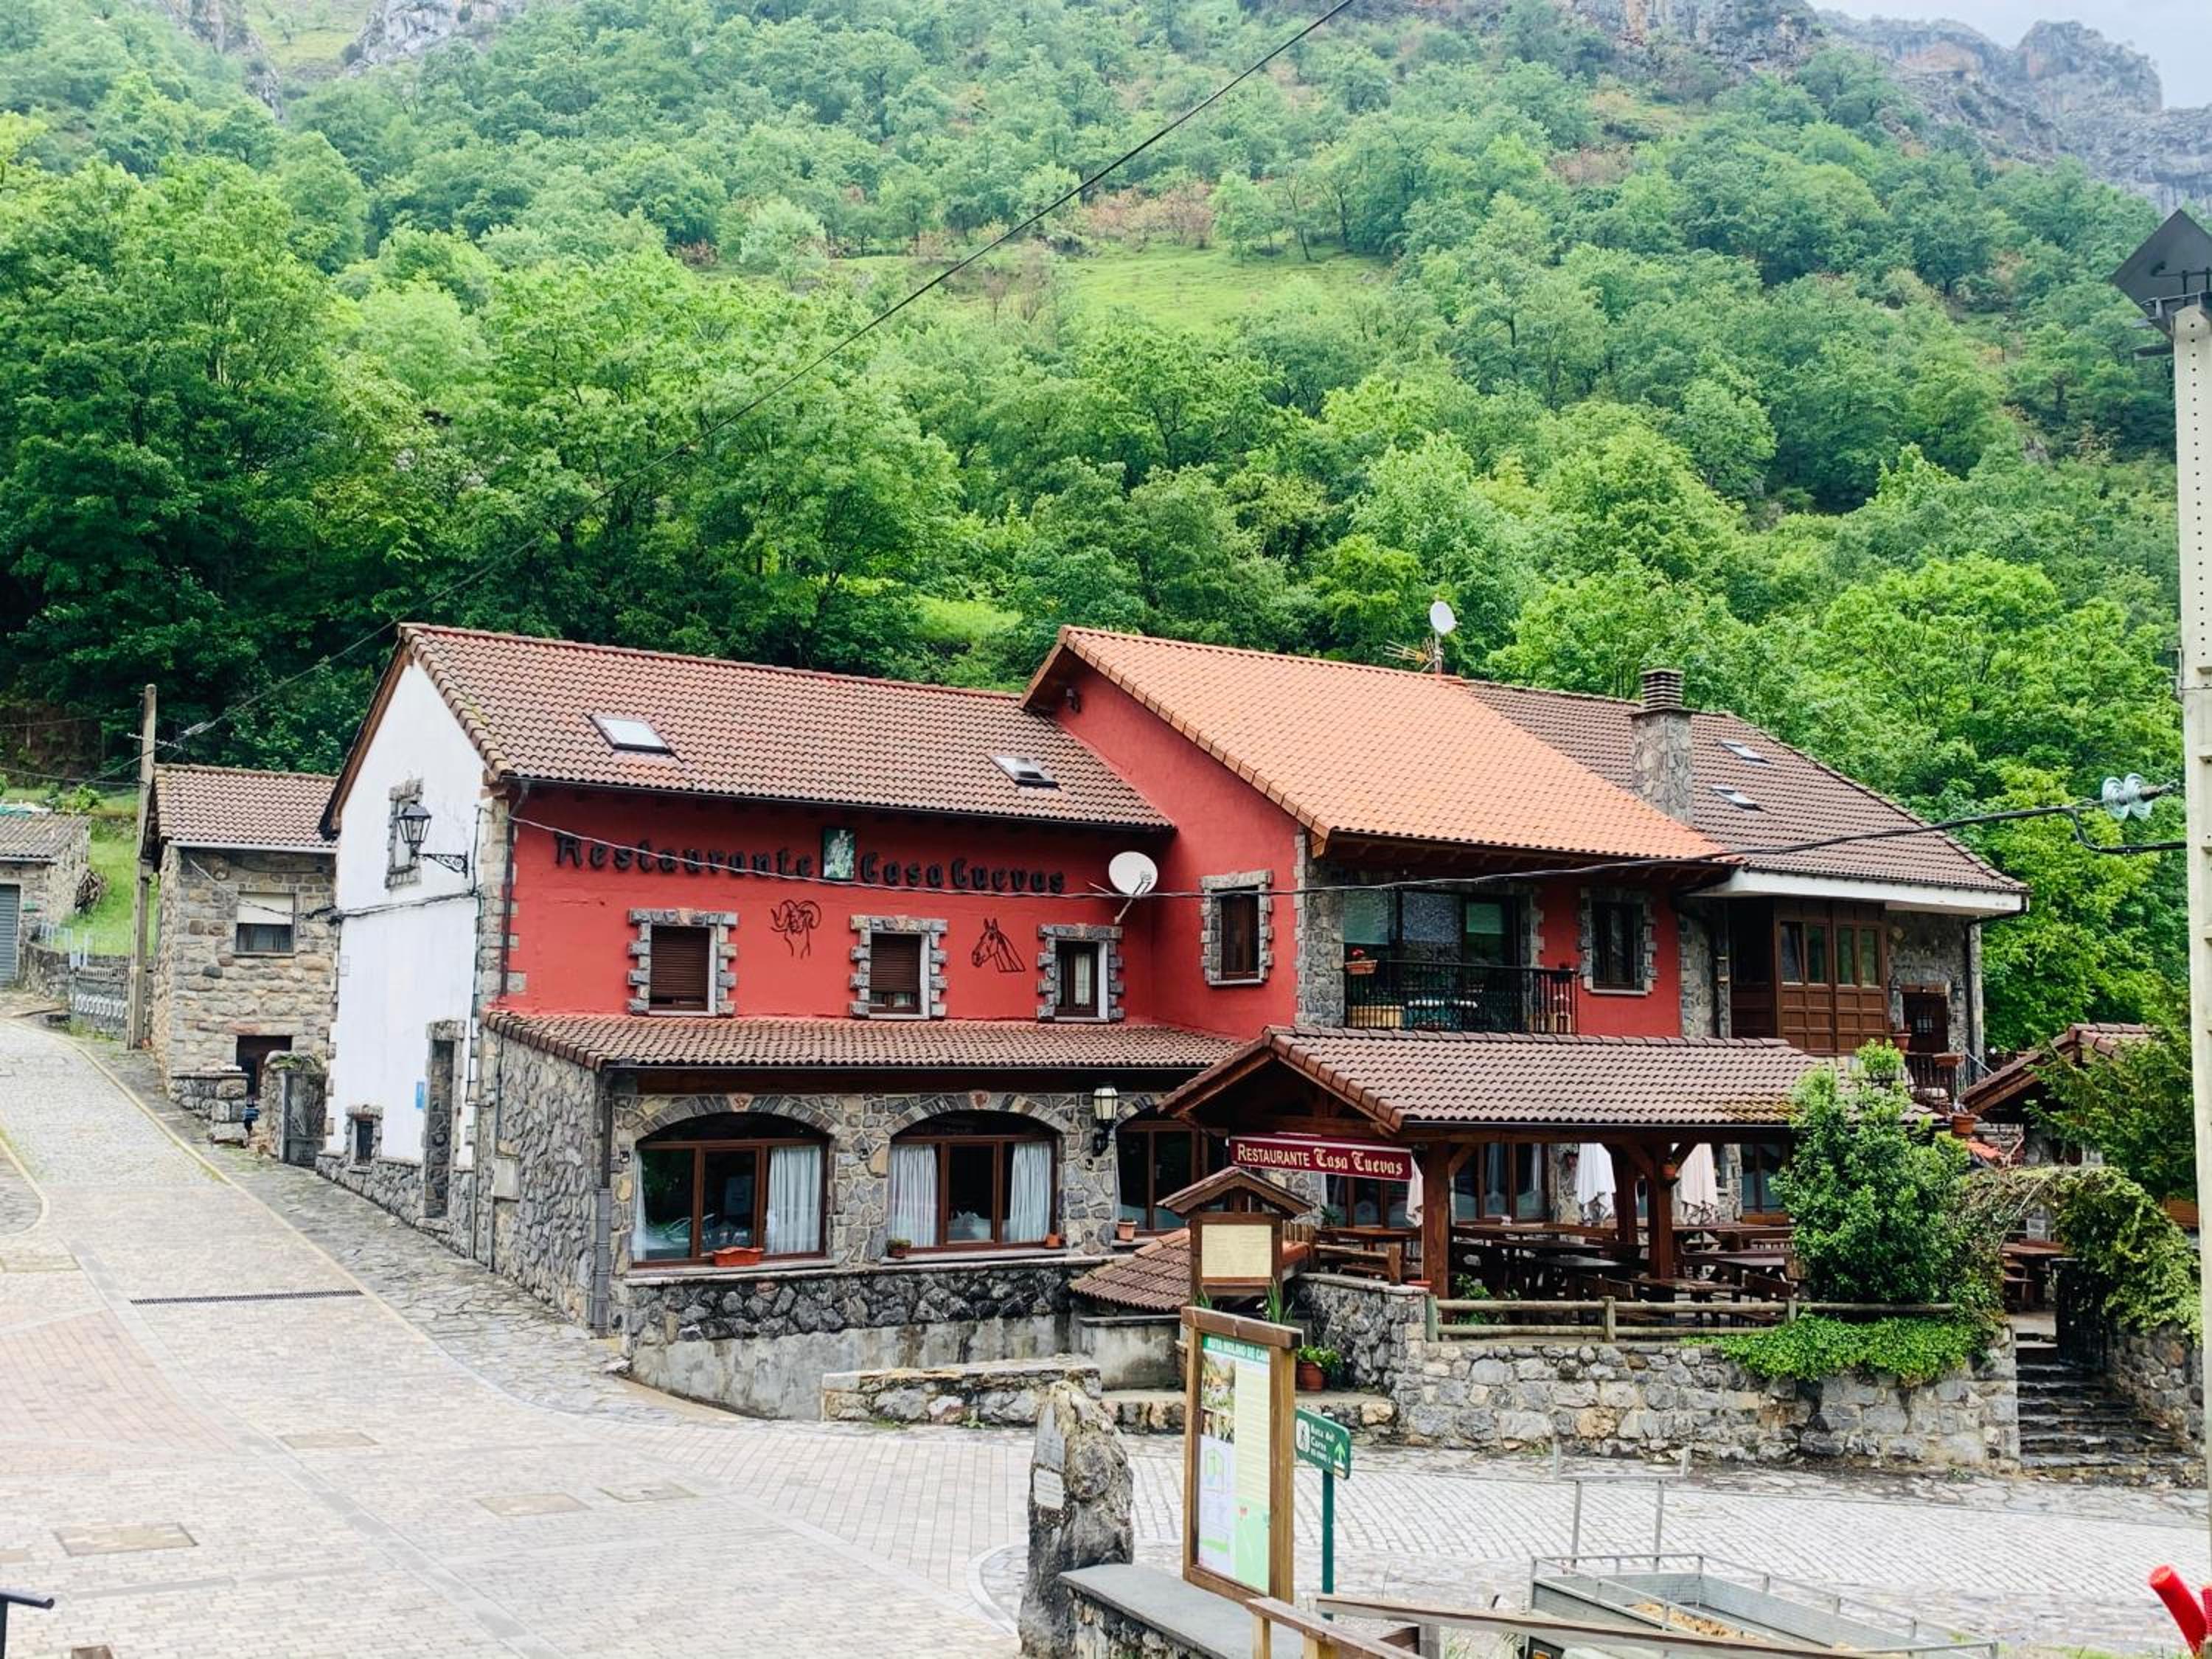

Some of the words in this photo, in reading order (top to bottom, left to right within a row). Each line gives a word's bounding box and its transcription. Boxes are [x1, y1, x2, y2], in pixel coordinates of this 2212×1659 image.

[555, 833, 813, 878] Restaurante
[860, 852, 945, 887] Casa
[950, 857, 1065, 894] Cuevas
[1237, 1144, 1310, 1167] RESTAURANTE
[1313, 1147, 1348, 1170] Casa
[1351, 1150, 1403, 1175] Cuevas
